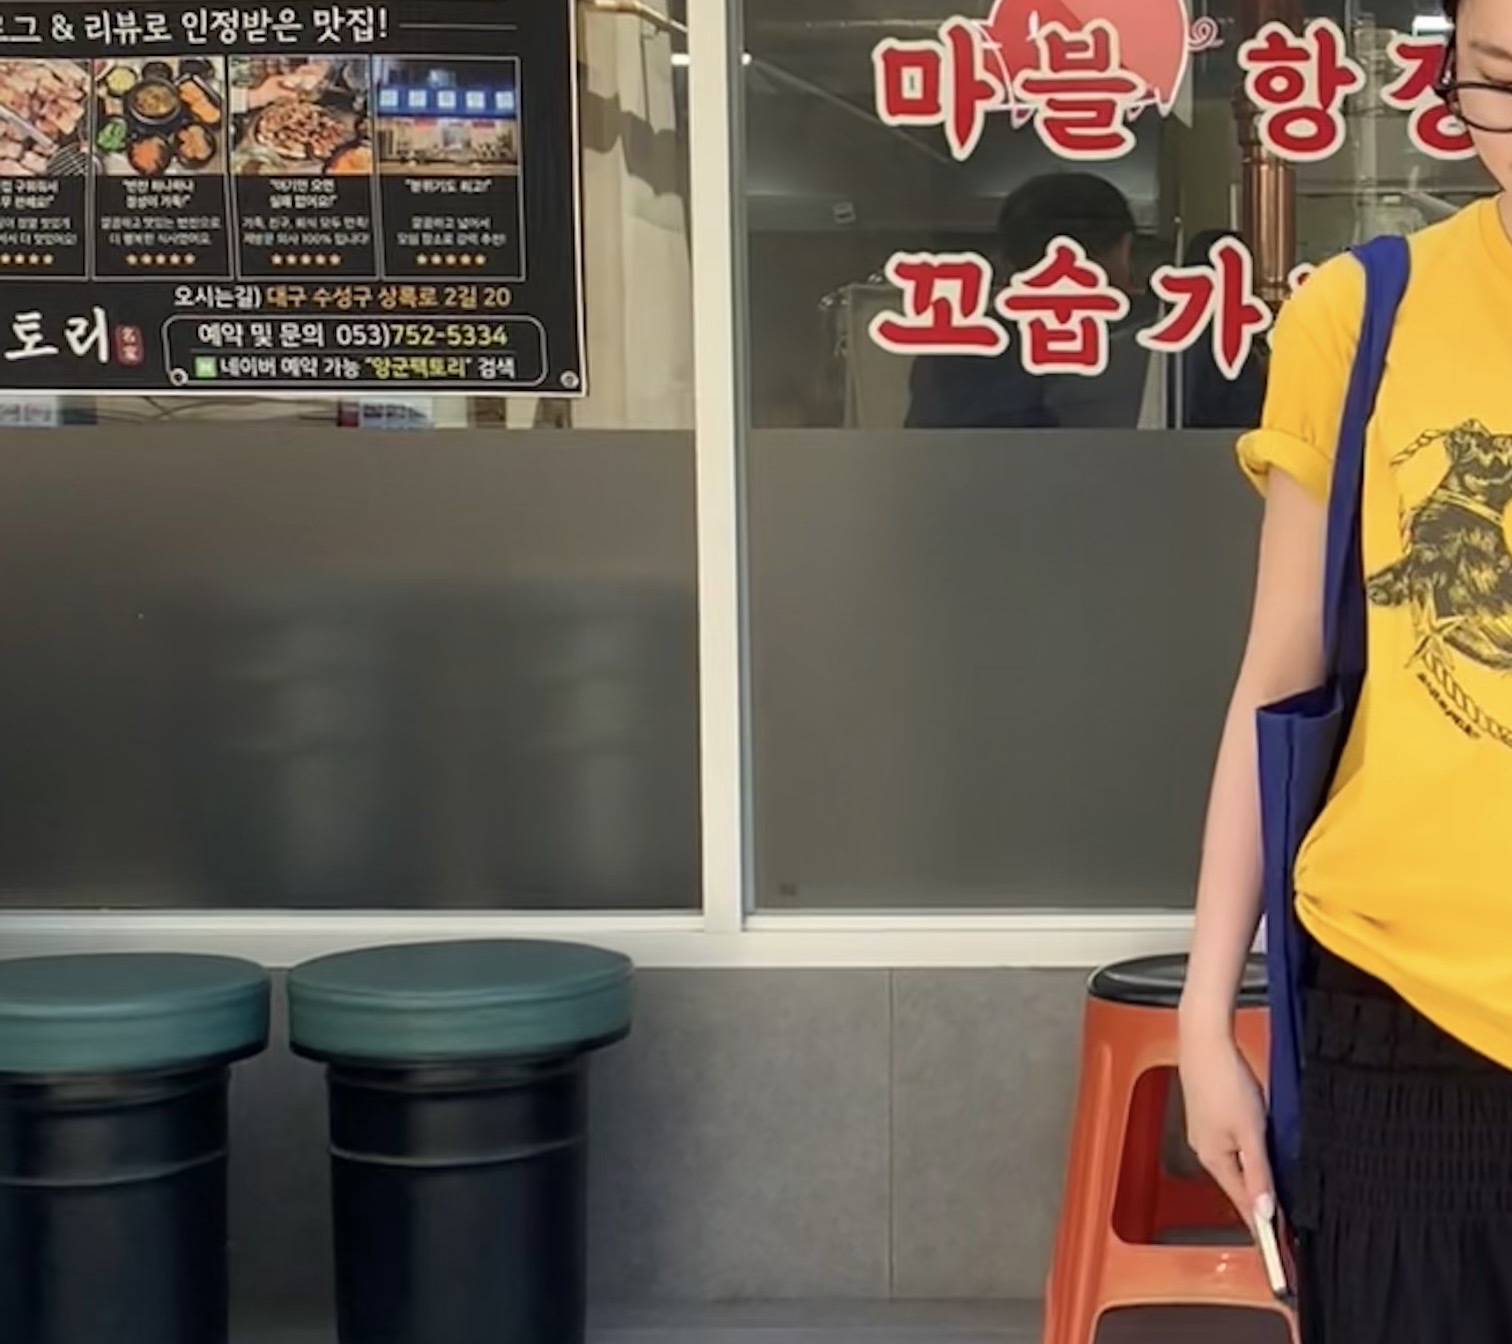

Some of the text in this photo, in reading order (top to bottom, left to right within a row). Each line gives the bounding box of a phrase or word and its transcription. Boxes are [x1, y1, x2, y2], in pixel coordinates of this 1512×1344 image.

[84, 9, 172, 45] 리뷰로
[181, 6, 303, 45] 인정받은
[312, 5, 388, 44] 맛집!
[874, 16, 1150, 162] 마블
[174, 284, 262, 309] 오시는길)
[267, 285, 307, 308] 대구
[312, 285, 373, 309] 수성구
[444, 285, 478, 309] 2길
[483, 286, 512, 307] 20
[869, 235, 1318, 381] 꼬숩가
[4, 305, 108, 364] 토리
[198, 322, 508, 348] 예약 및 문의 053)752-5334
[219, 356, 277, 378] 네이버
[280, 356, 318, 378] 예약
[323, 356, 361, 380] 가능
[478, 356, 516, 380] 검색
